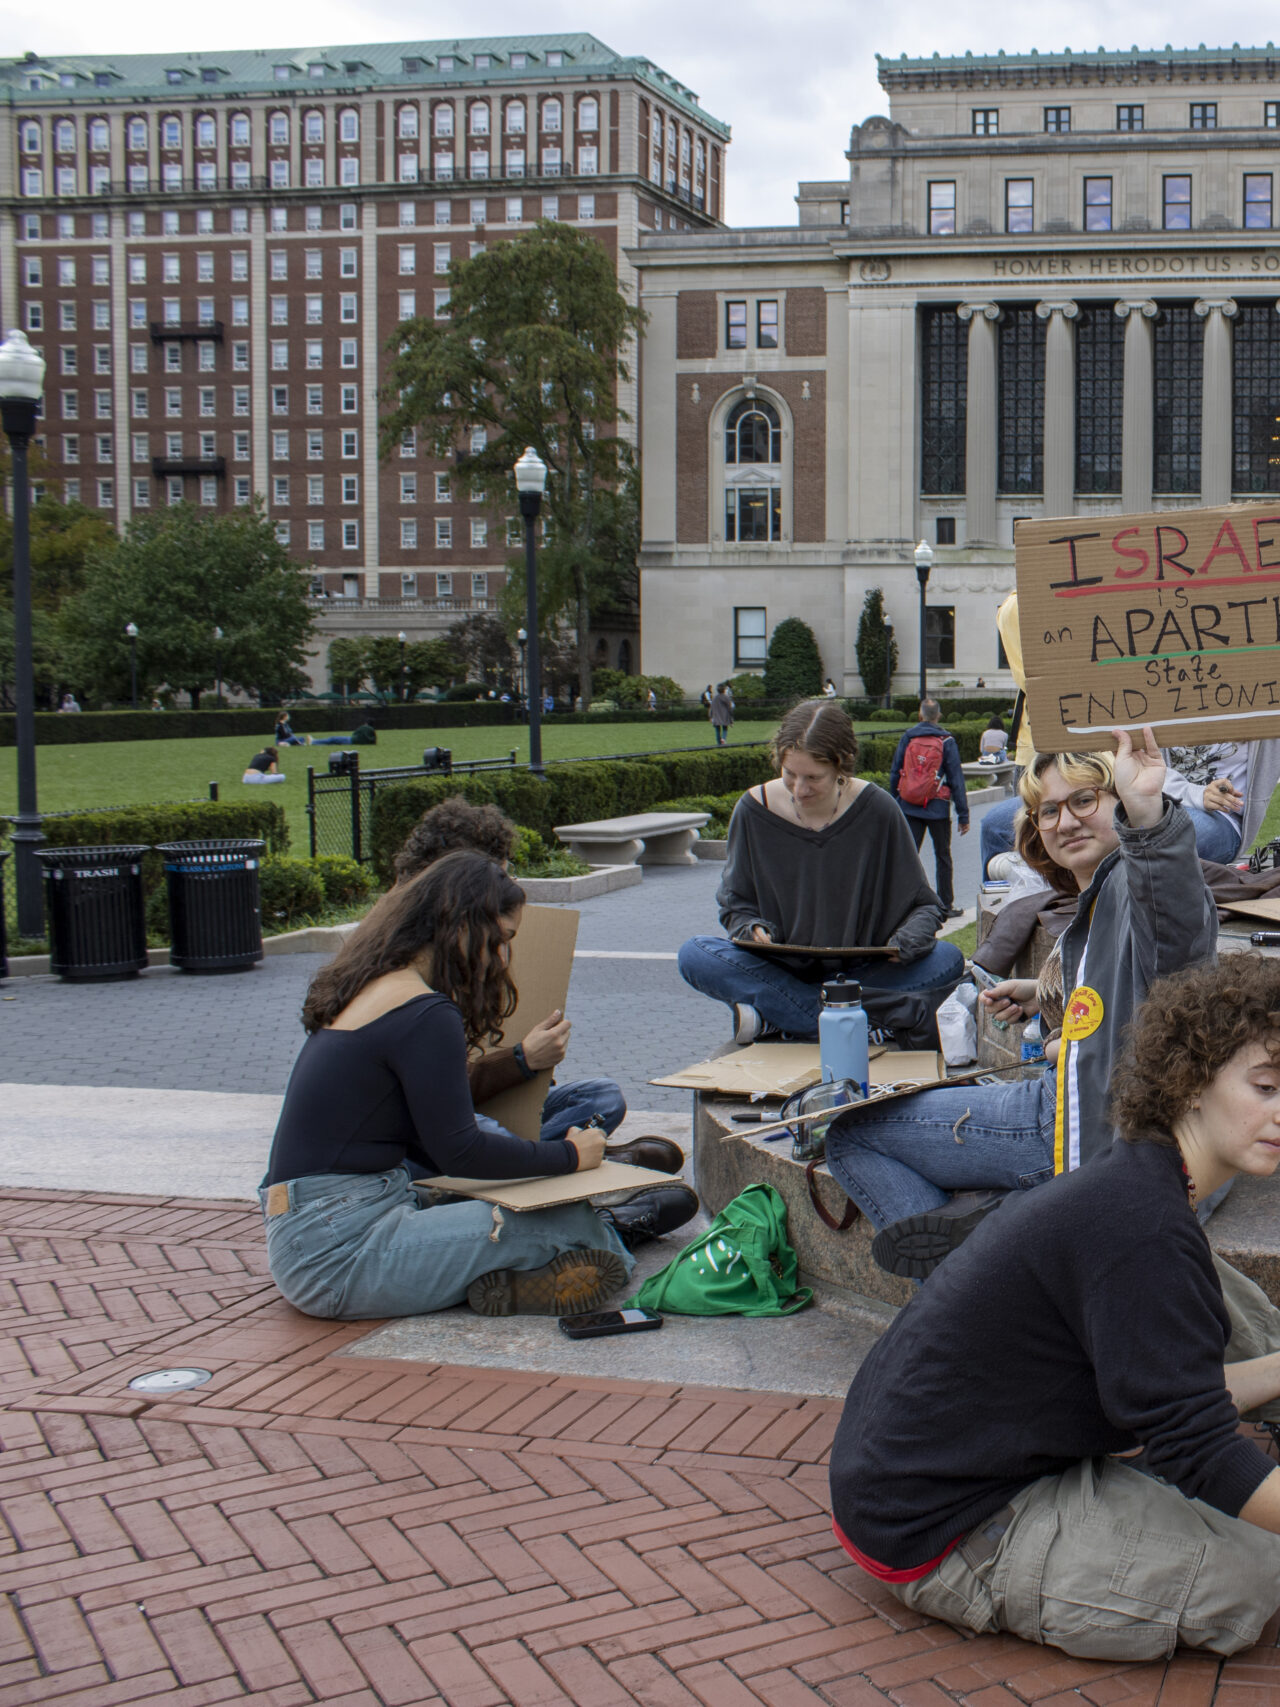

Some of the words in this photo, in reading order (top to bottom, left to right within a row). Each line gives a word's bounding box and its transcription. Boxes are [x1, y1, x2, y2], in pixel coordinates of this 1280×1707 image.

[993, 258, 1073, 276] HOMER
[1089, 256, 1232, 274] HERODOTUS
[1157, 587, 1189, 608] is
[1043, 626, 1073, 644] an
[1059, 688, 1148, 725] END
[73, 868, 119, 878] TRASH
